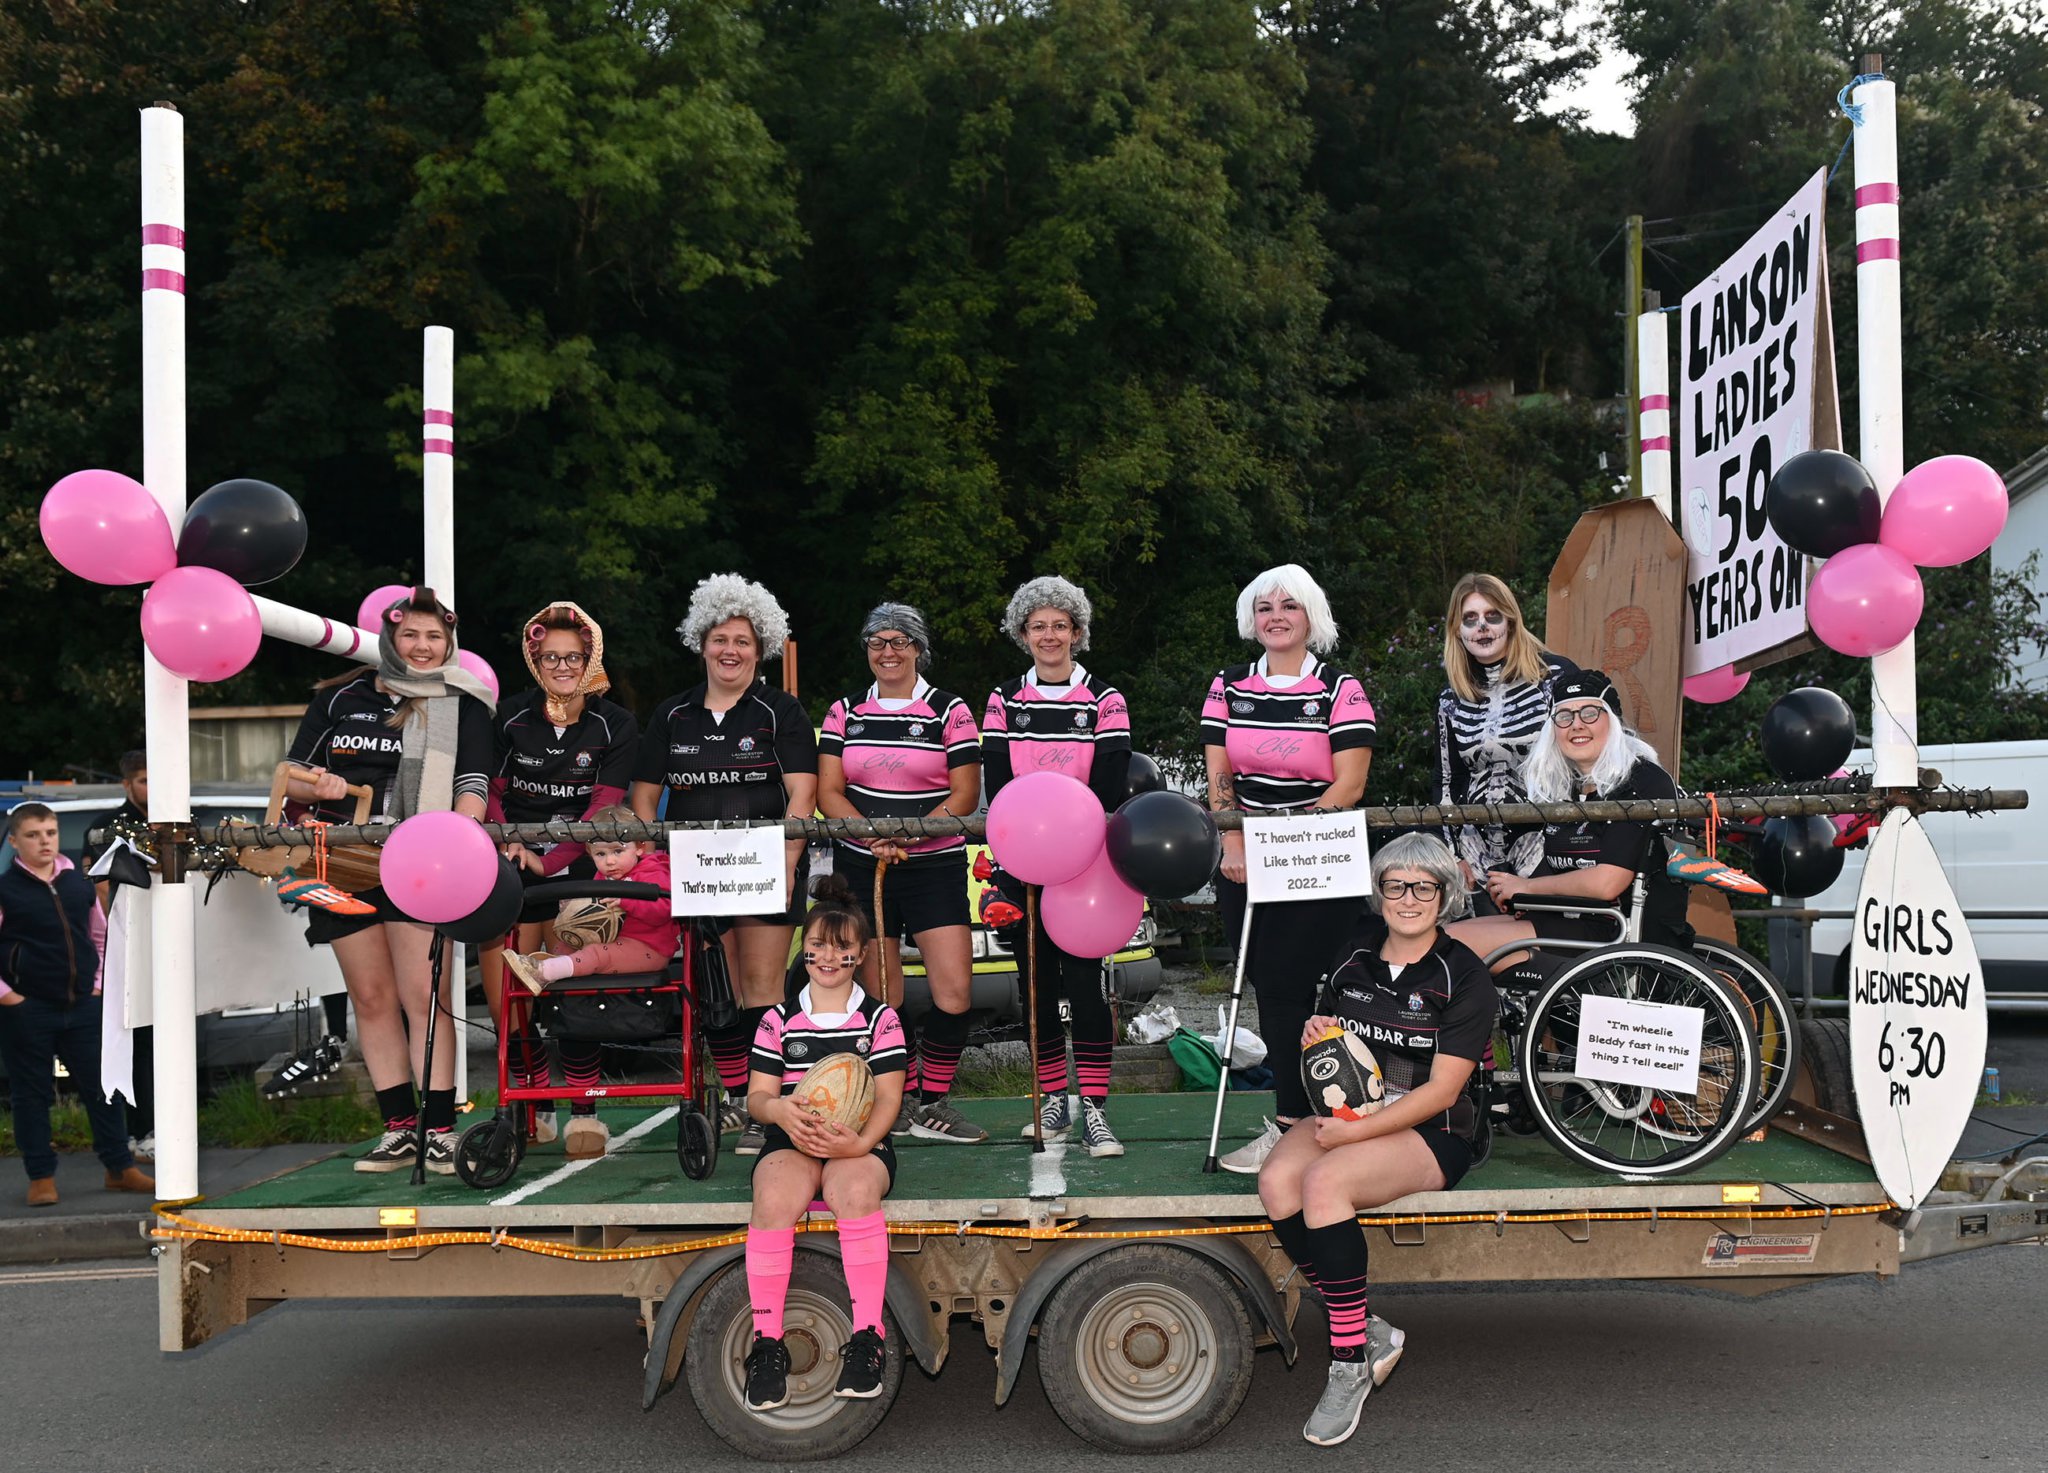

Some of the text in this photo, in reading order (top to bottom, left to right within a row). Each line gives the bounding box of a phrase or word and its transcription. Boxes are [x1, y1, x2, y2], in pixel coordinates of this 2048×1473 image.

[1687, 213, 1812, 382] LANSON
[1694, 319, 1798, 458] LADIES
[1718, 434, 1774, 565] 50
[1687, 545, 1803, 645] YEARS ON
[332, 735, 403, 753] DOOM BA
[512, 775, 549, 795] DOOM
[550, 784, 575, 798] BAR
[668, 771, 741, 785] DOOM BAR
[1255, 826, 1356, 844] "I haven't rucked
[1263, 853, 1352, 868] Like that since
[682, 881, 706, 894] That's
[706, 884, 718, 897] my
[719, 879, 736, 893] back
[737, 881, 754, 896] gone
[1864, 897, 1954, 956] GIRLS
[1515, 971, 1543, 980] KARMA
[1855, 966, 1971, 1010] WEDNESDAY
[1397, 1009, 1432, 1018] LAUNCESTON
[1334, 1015, 1405, 1048] OOM BAR
[1632, 1025, 1674, 1037] wheelie
[1588, 1034, 1690, 1056] Bleddy fast in this
[1878, 1021, 1946, 1079] 6:30
[1591, 1051, 1619, 1064] thing
[1622, 1055, 1629, 1064] I
[1632, 1058, 1651, 1067] tell
[1889, 1081, 1911, 1107] PM
[1740, 1236, 1803, 1246] ENGINEERING
